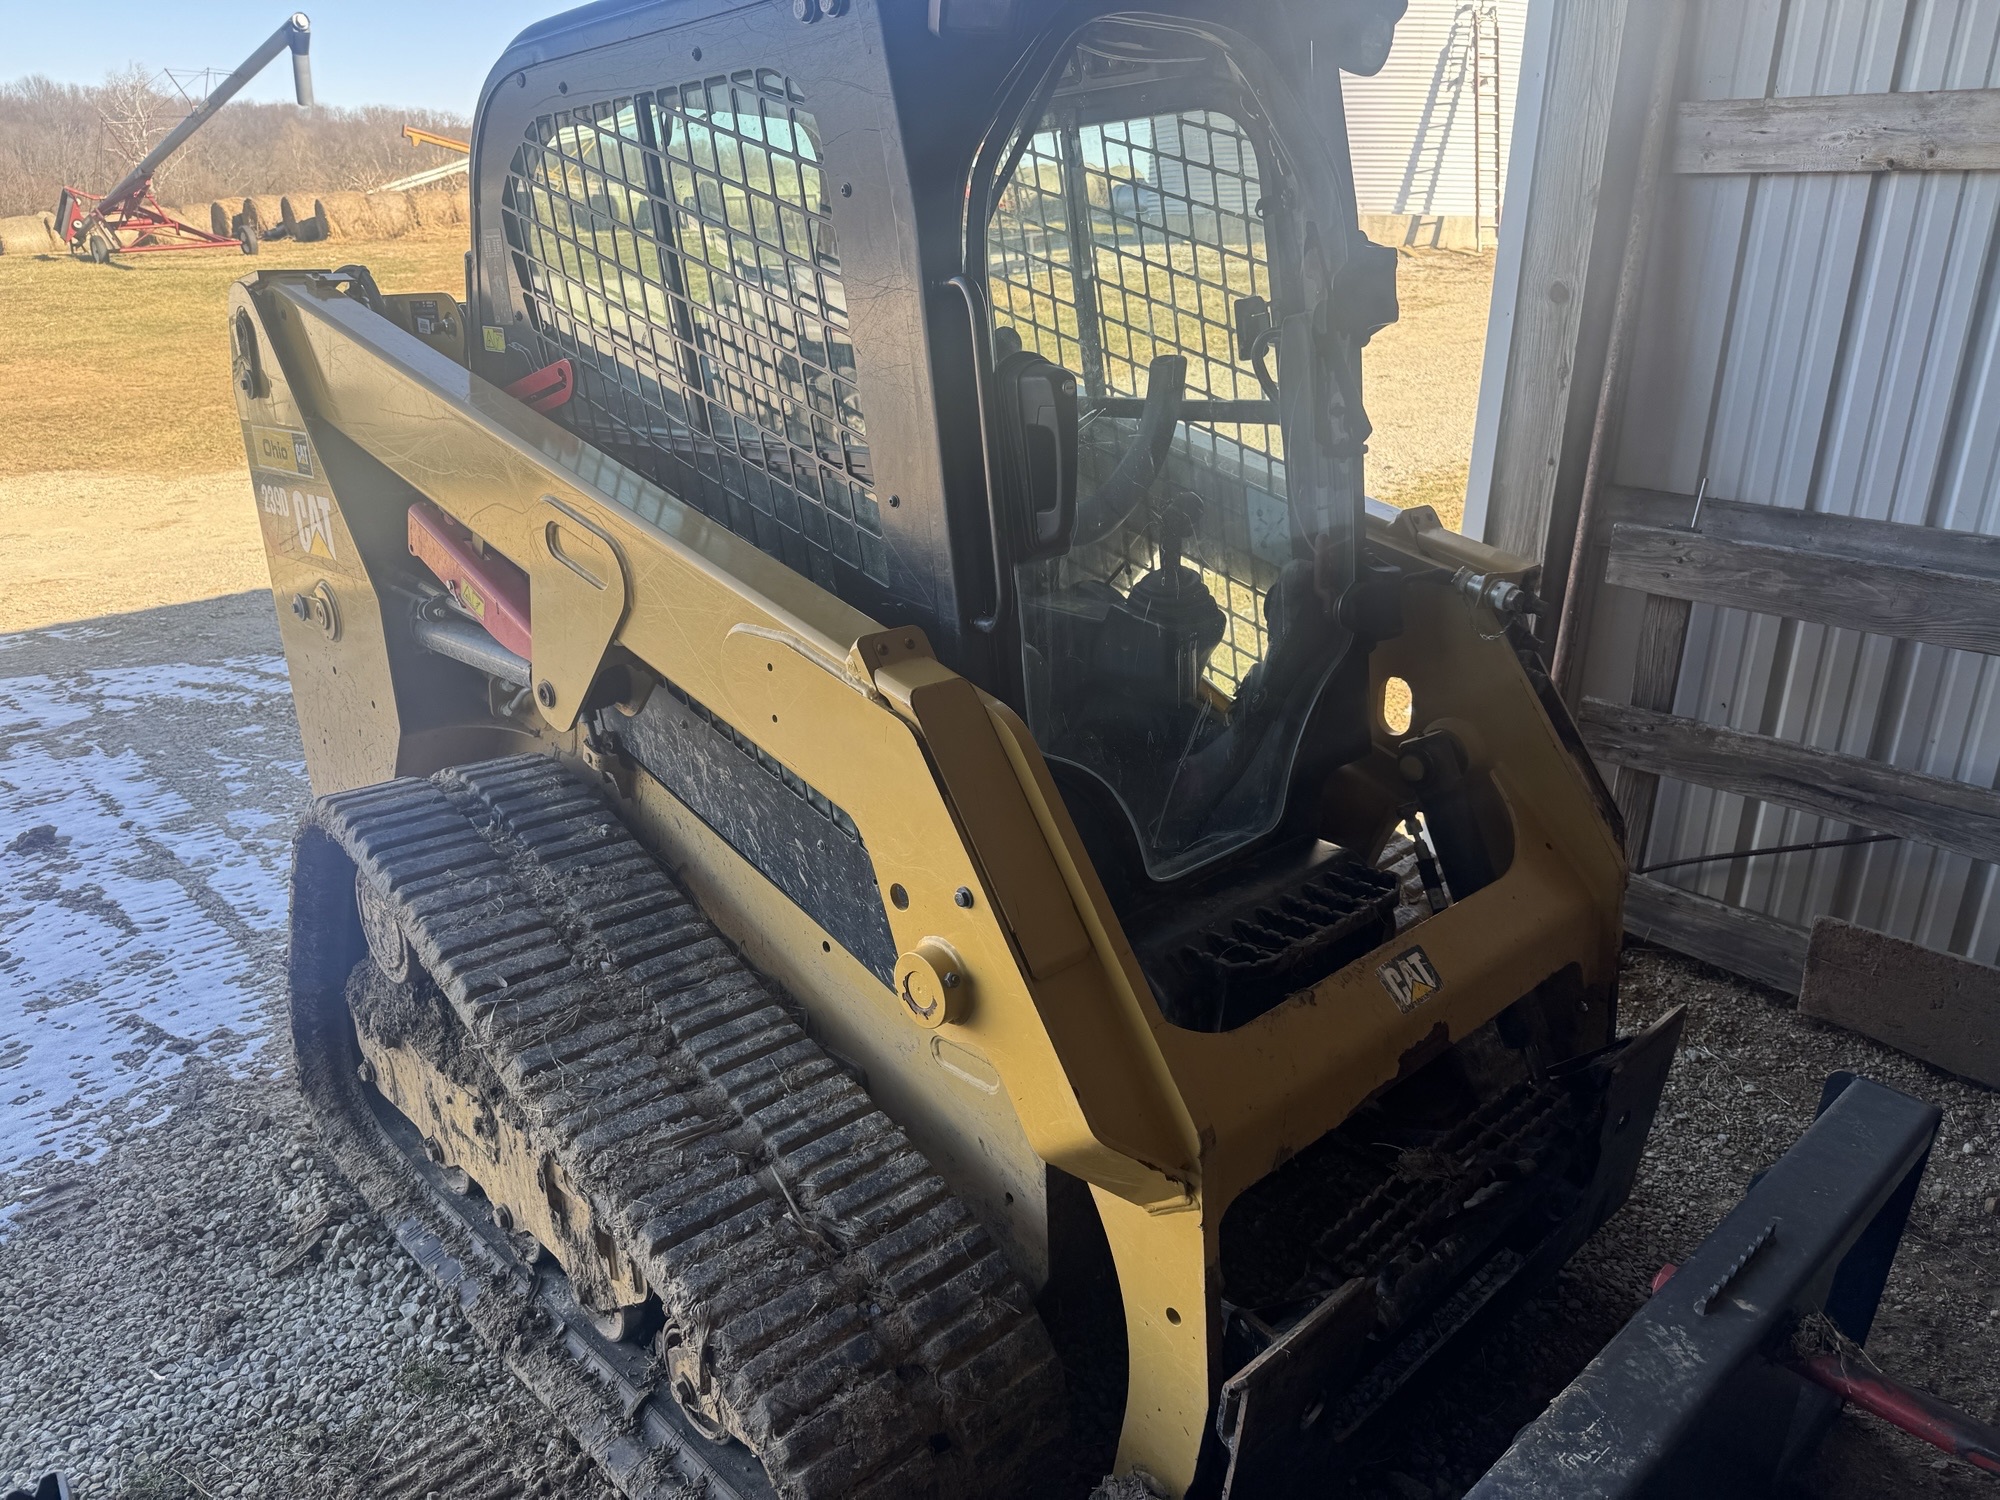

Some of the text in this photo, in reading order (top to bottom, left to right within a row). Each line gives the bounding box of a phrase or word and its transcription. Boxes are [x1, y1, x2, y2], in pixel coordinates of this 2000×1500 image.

[262, 438, 309, 465] Ohio CAT
[261, 483, 290, 517] 239D
[292, 490, 337, 561] CAT
[1383, 951, 1436, 1006] CAT
